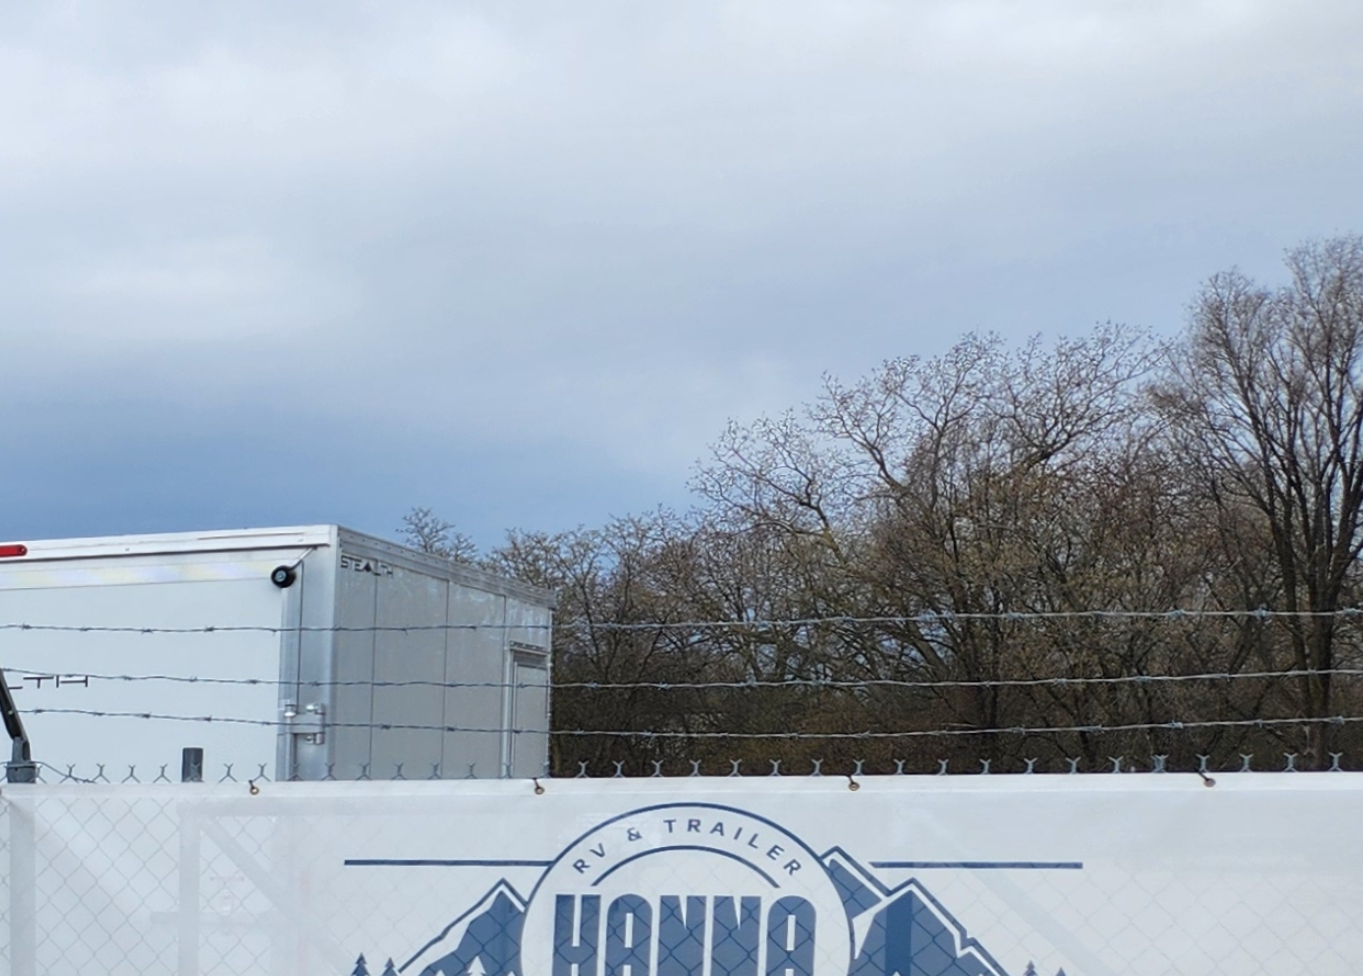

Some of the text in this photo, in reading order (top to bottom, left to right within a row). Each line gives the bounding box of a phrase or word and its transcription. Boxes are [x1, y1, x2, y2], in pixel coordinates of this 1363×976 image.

[572, 818, 802, 876] RV & TRAILER
